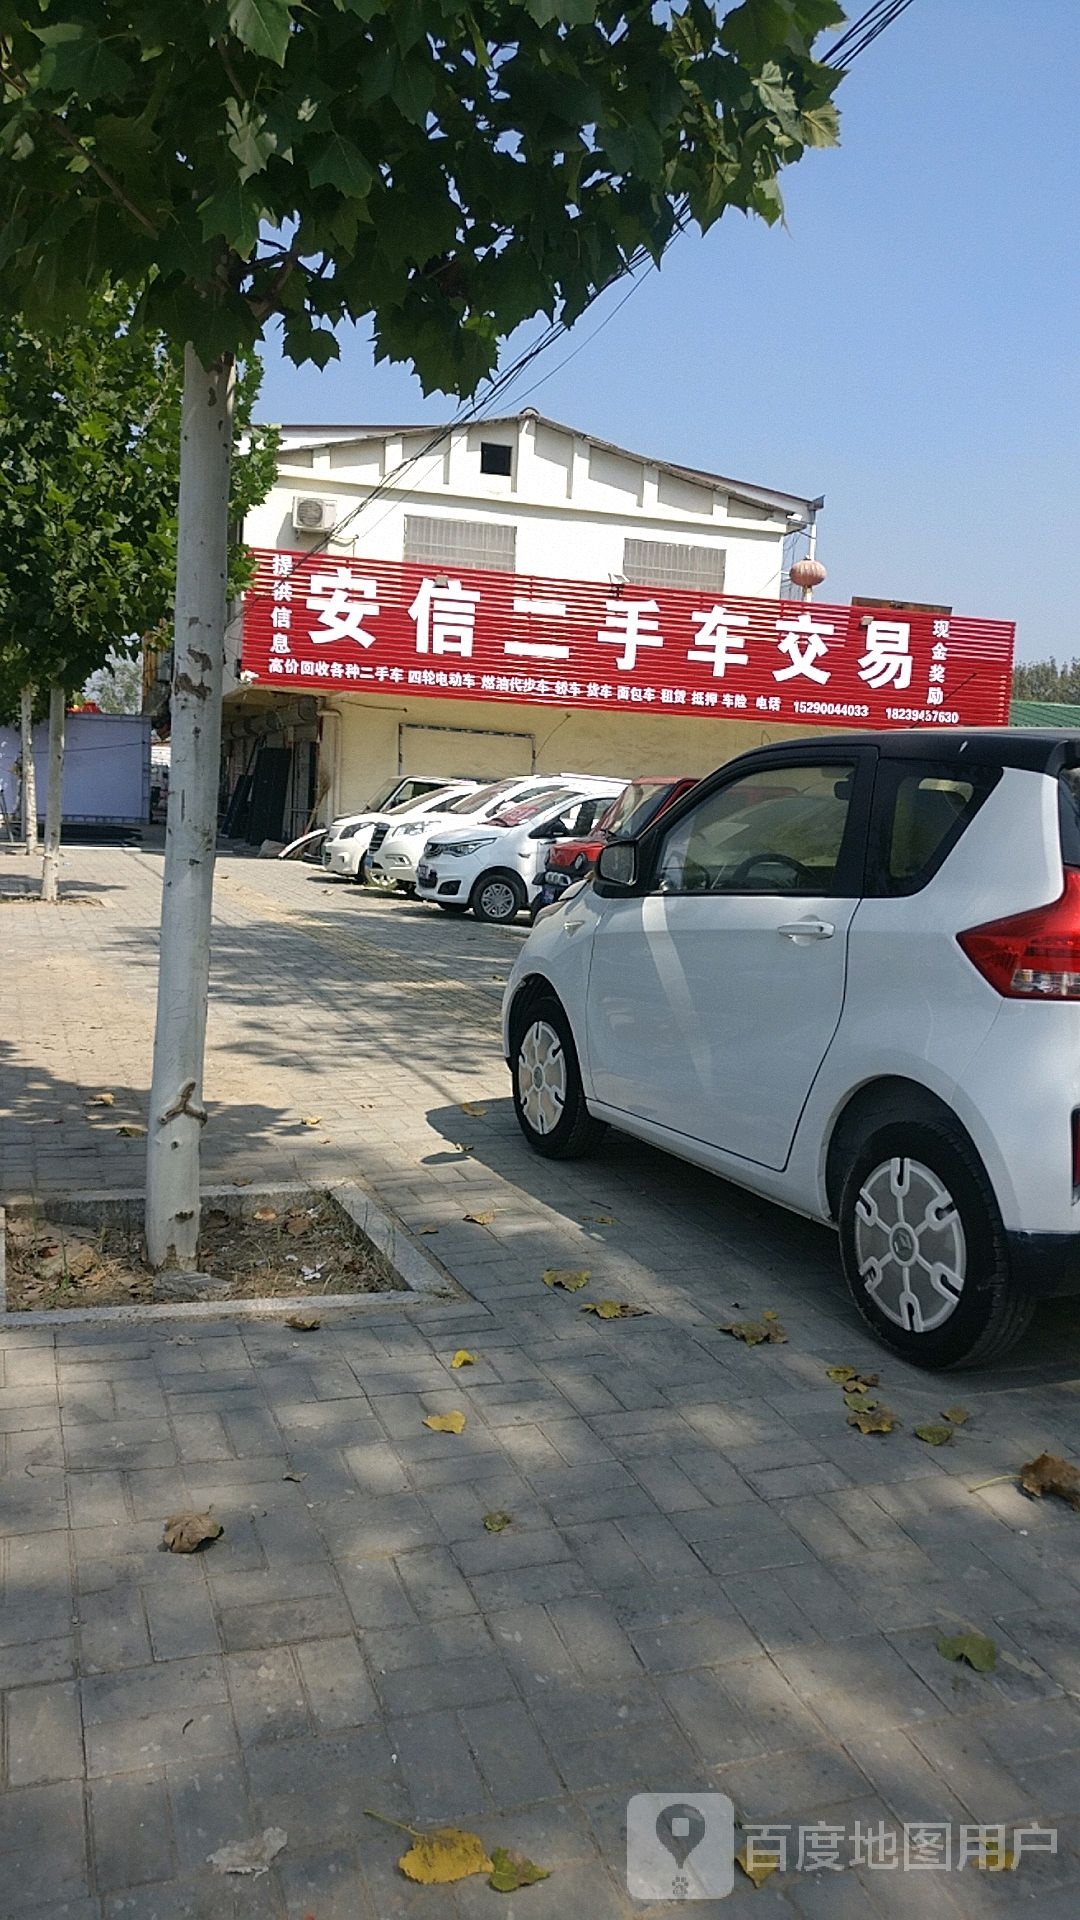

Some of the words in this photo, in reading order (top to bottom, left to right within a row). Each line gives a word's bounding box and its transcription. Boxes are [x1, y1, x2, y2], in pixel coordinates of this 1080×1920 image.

[270, 555, 294, 654] 提供信息
[306, 566, 914, 690] 安信二手车交易
[268, 658, 404, 683] 高价回收各种二手车
[408, 669, 476, 688] 四轮电动车
[481, 675, 549, 694] 燃油代步车
[555, 680, 581, 697] 轿车
[586, 682, 613, 698] 货车
[617, 684, 656, 703] 面包车
[691, 690, 718, 707] 抵押
[722, 693, 748, 709] 车险
[756, 695, 782, 711] 电话
[793, 700, 869, 717] 15290044033
[926, 619, 951, 706] 现金奖励
